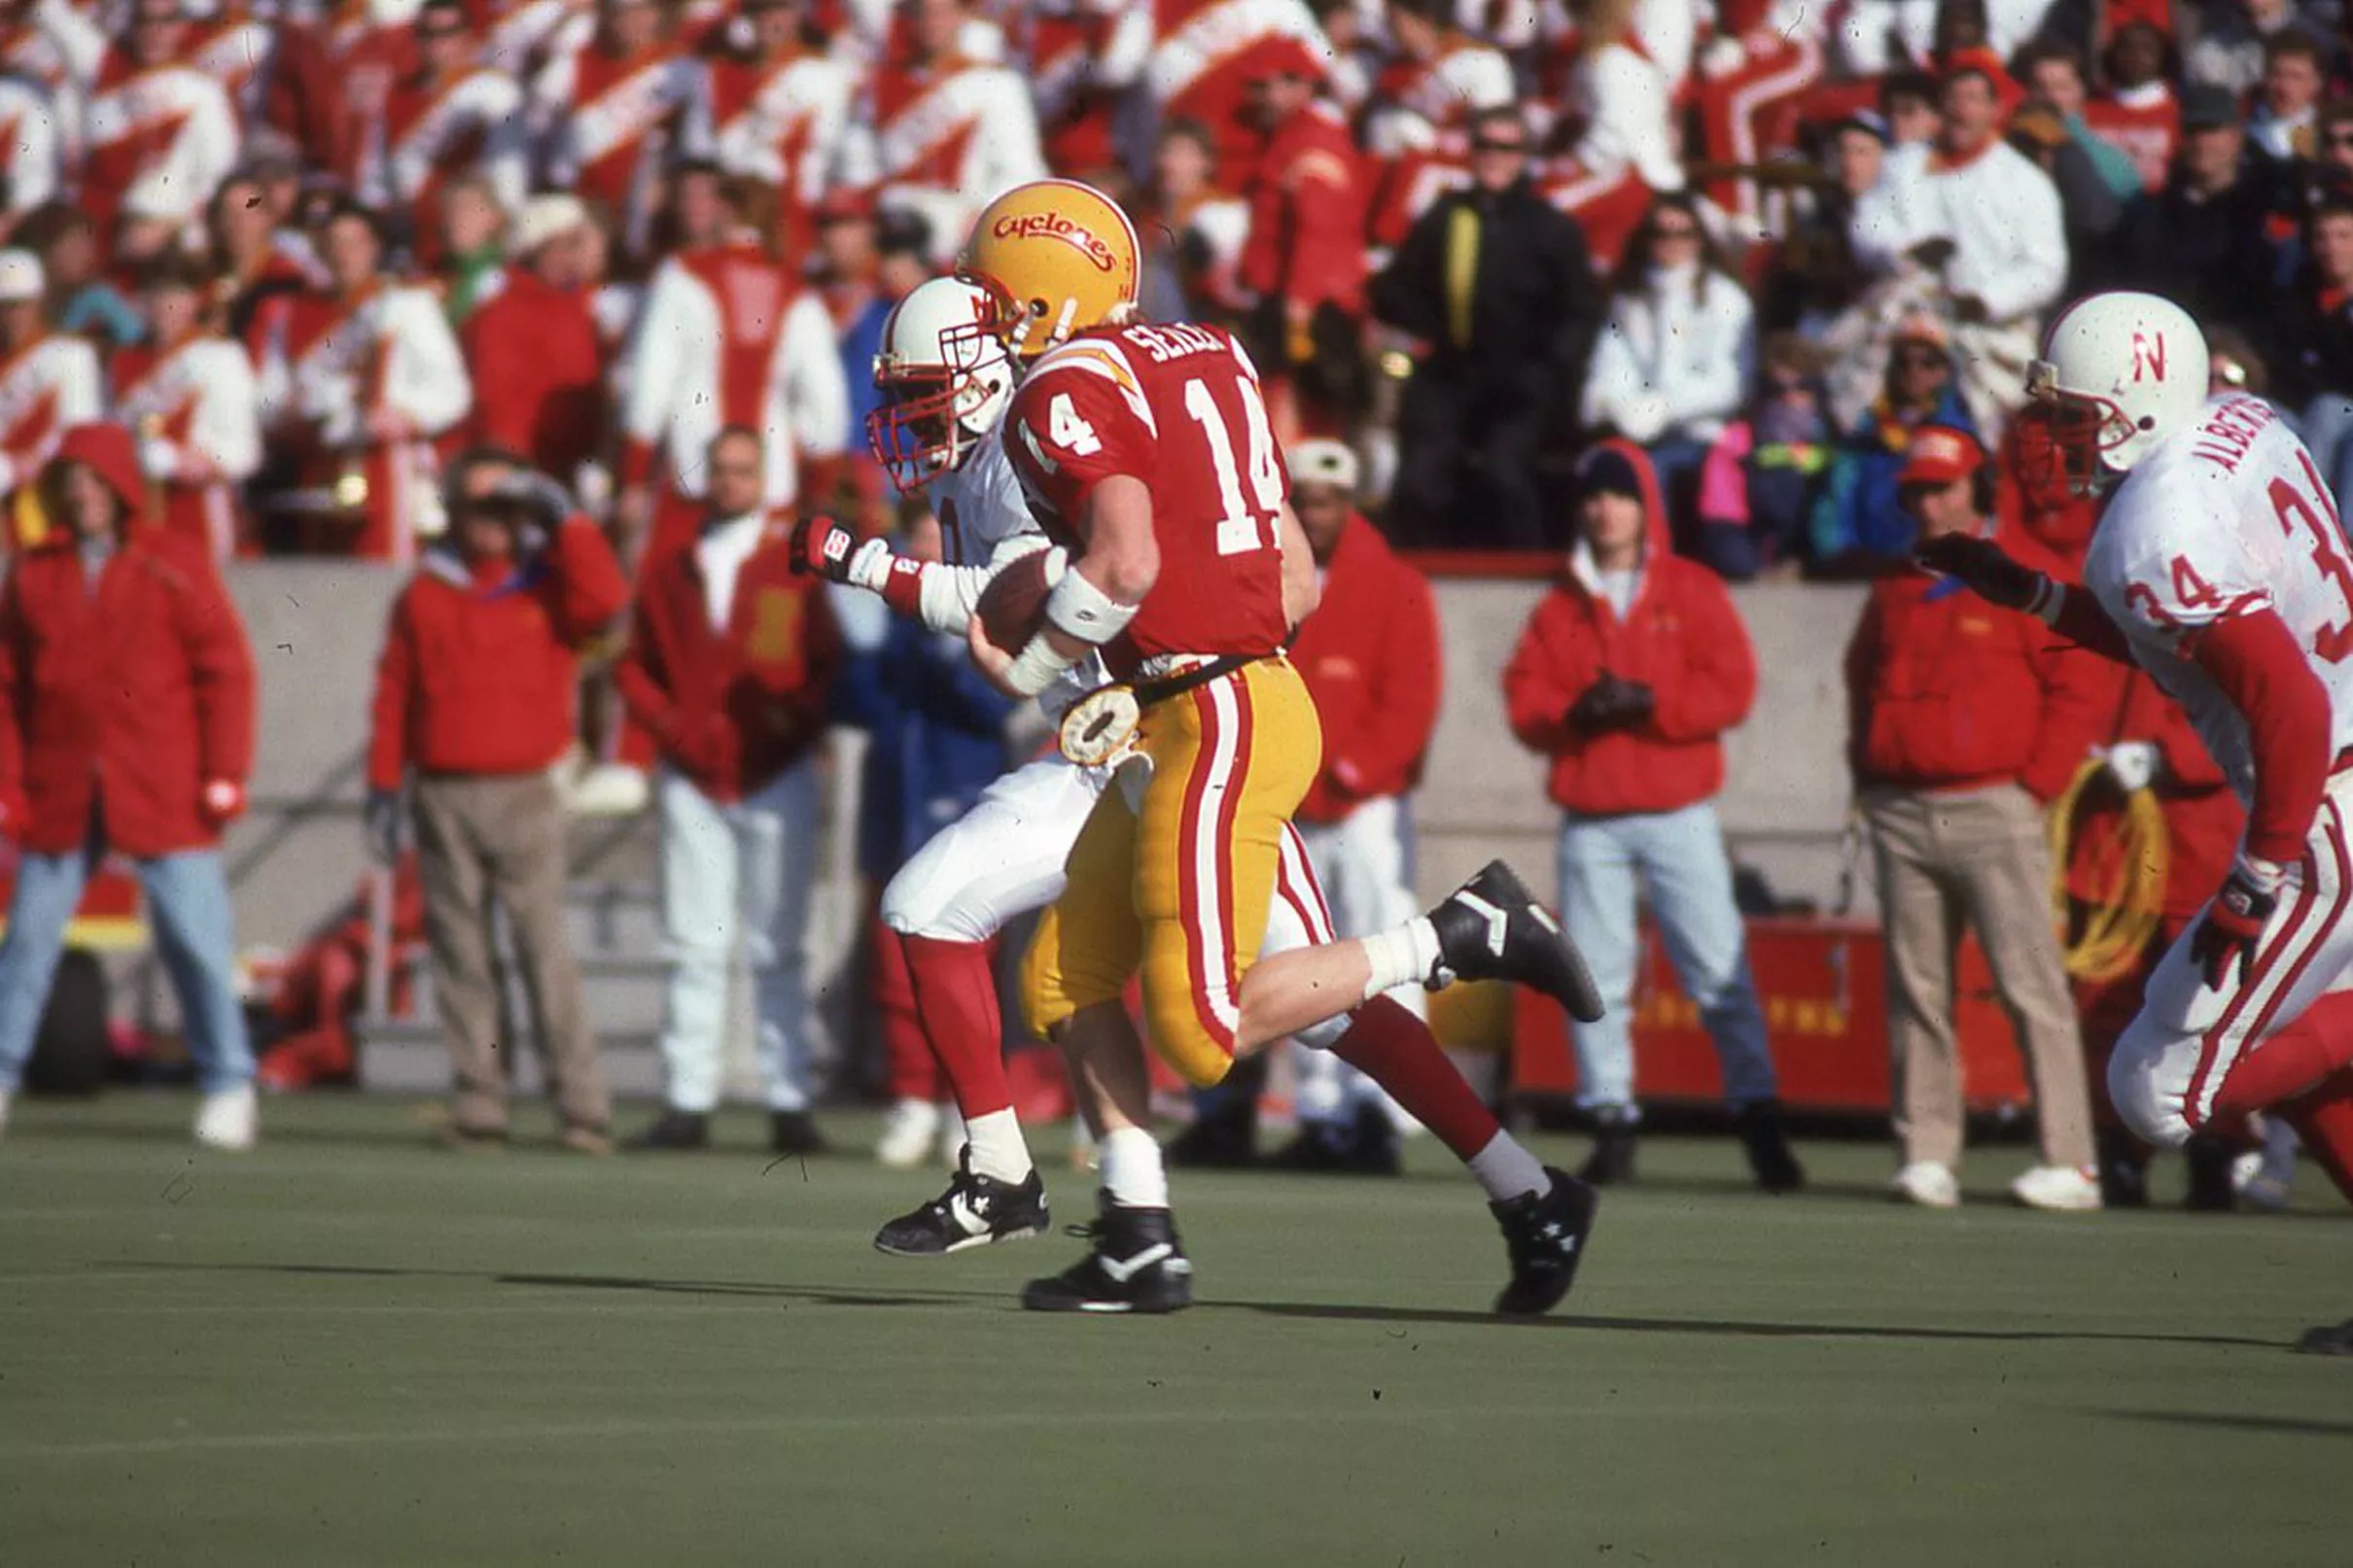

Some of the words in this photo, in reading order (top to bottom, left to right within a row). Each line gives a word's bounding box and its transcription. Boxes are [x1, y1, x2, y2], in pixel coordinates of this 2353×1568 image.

[994, 212, 1117, 273] Cyclones
[2132, 331, 2164, 382] N
[1184, 375, 1283, 555] 14
[2124, 554, 2221, 656] 34
[2267, 448, 2353, 664] 3
